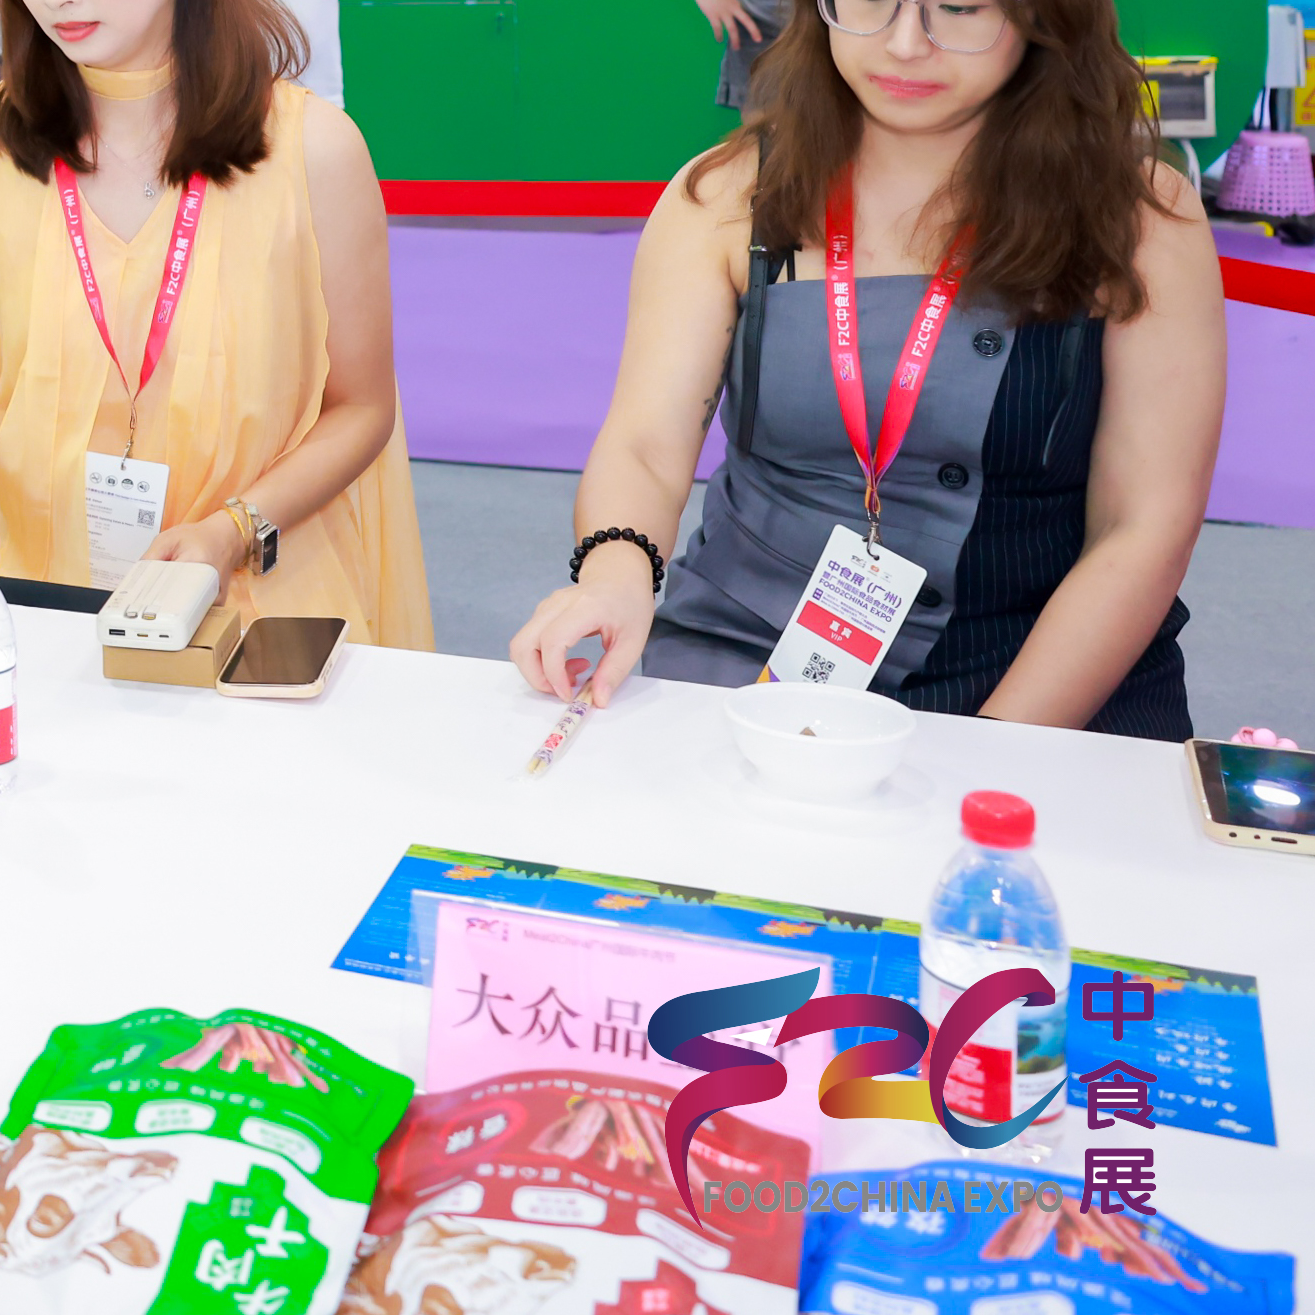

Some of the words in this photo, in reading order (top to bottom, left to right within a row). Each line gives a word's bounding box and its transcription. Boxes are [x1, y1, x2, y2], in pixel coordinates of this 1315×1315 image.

[819, 578, 868, 610] FOOD2CHINA
[870, 607, 892, 622] EXPO
[831, 632, 843, 642] VIP
